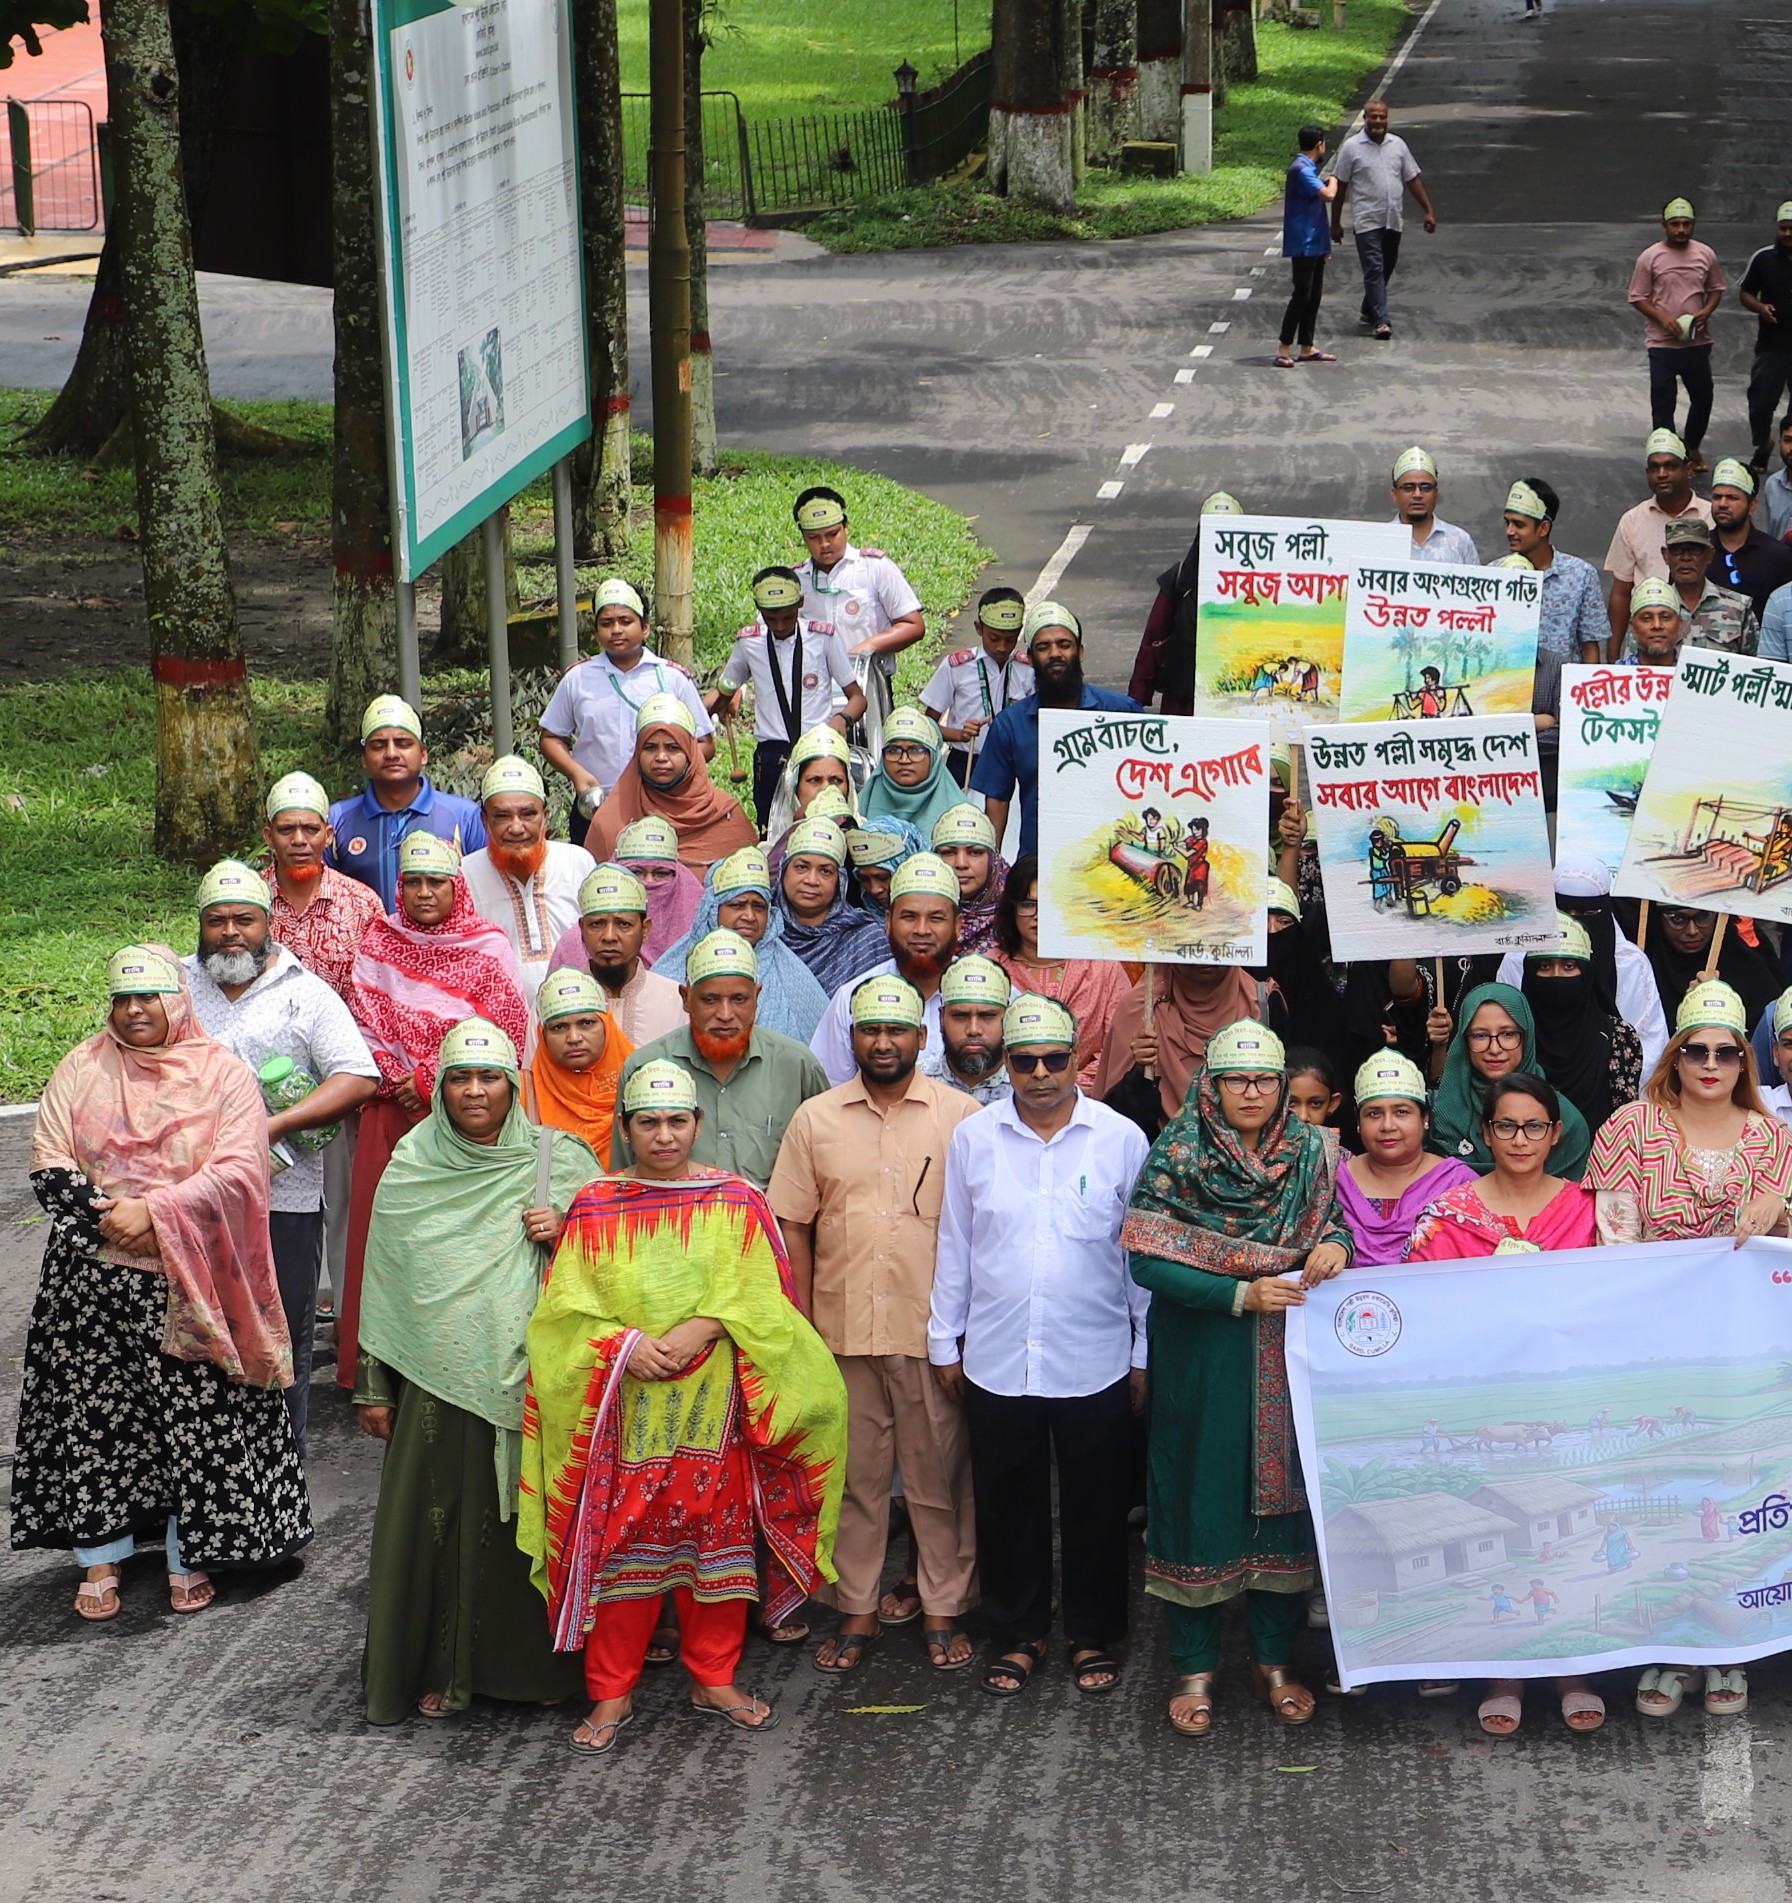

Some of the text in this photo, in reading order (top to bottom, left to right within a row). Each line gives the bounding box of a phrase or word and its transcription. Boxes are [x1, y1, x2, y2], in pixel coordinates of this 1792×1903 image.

[1215, 525, 1334, 569] সবুজ পল্লী,
[1217, 570, 1282, 607] সবুজ
[1357, 567, 1408, 596] সবার
[1413, 572, 1502, 603] অংশগ্রহণে
[1363, 594, 1497, 634] উন্নত পল্লী
[1570, 667, 1673, 709] পল্লীর উন্ন
[1680, 658, 1731, 697] স্মার্ট
[1730, 666, 1776, 708] পল্লী
[1053, 714, 1180, 773] গ্রাম বাঁচলে,
[1310, 731, 1531, 771] উন্নত পল্লী সমৃদ্ধ দেশ
[1115, 743, 1265, 803] দেশ এগোবে
[1316, 770, 1540, 812] সবার আগে বাংলাদেশ
[1209, 942, 1254, 963] কুমিল্লা
[1366, 1340, 1390, 1355] CUMILLA
